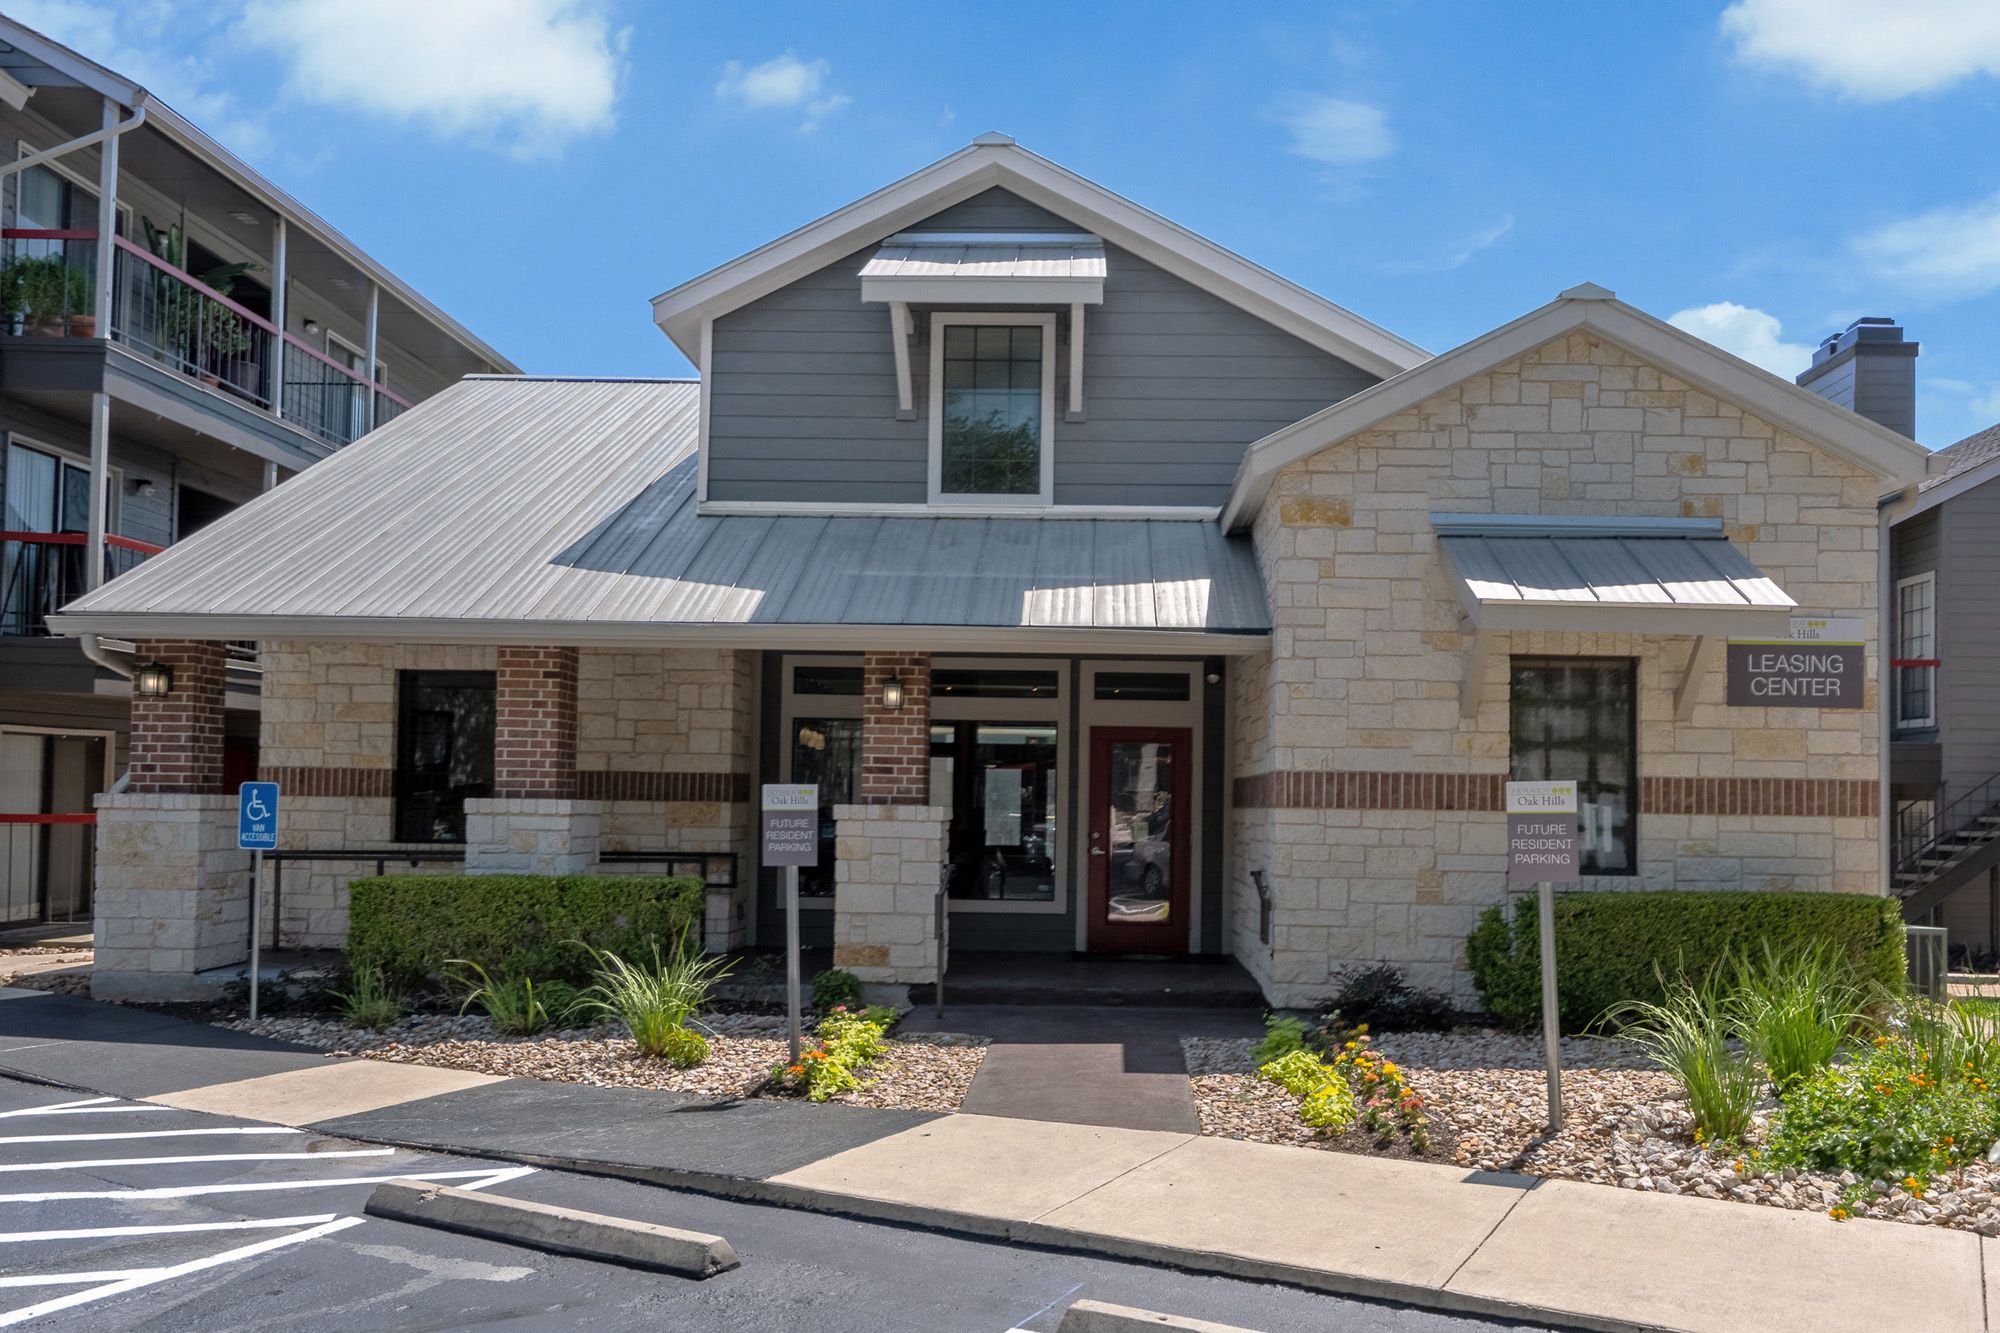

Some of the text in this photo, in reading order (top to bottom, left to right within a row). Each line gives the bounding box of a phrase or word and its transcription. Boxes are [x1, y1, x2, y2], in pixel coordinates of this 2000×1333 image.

[1797, 628, 1820, 639] Hills
[1748, 654, 1844, 673] LEASING
[1750, 677, 1841, 696] CENTER
[771, 796, 809, 805] Oak Hills
[1517, 795, 1566, 806] Oak Hills
[252, 823, 265, 832] VAN
[771, 818, 809, 828] FUTURE
[766, 830, 814, 840] RESIDENT
[1517, 824, 1567, 835] FUTURE
[241, 832, 275, 841] ACCESSIBLE
[768, 842, 812, 852] PARKING
[1511, 839, 1573, 850] RESIDENT
[1515, 853, 1570, 865] PARKING
